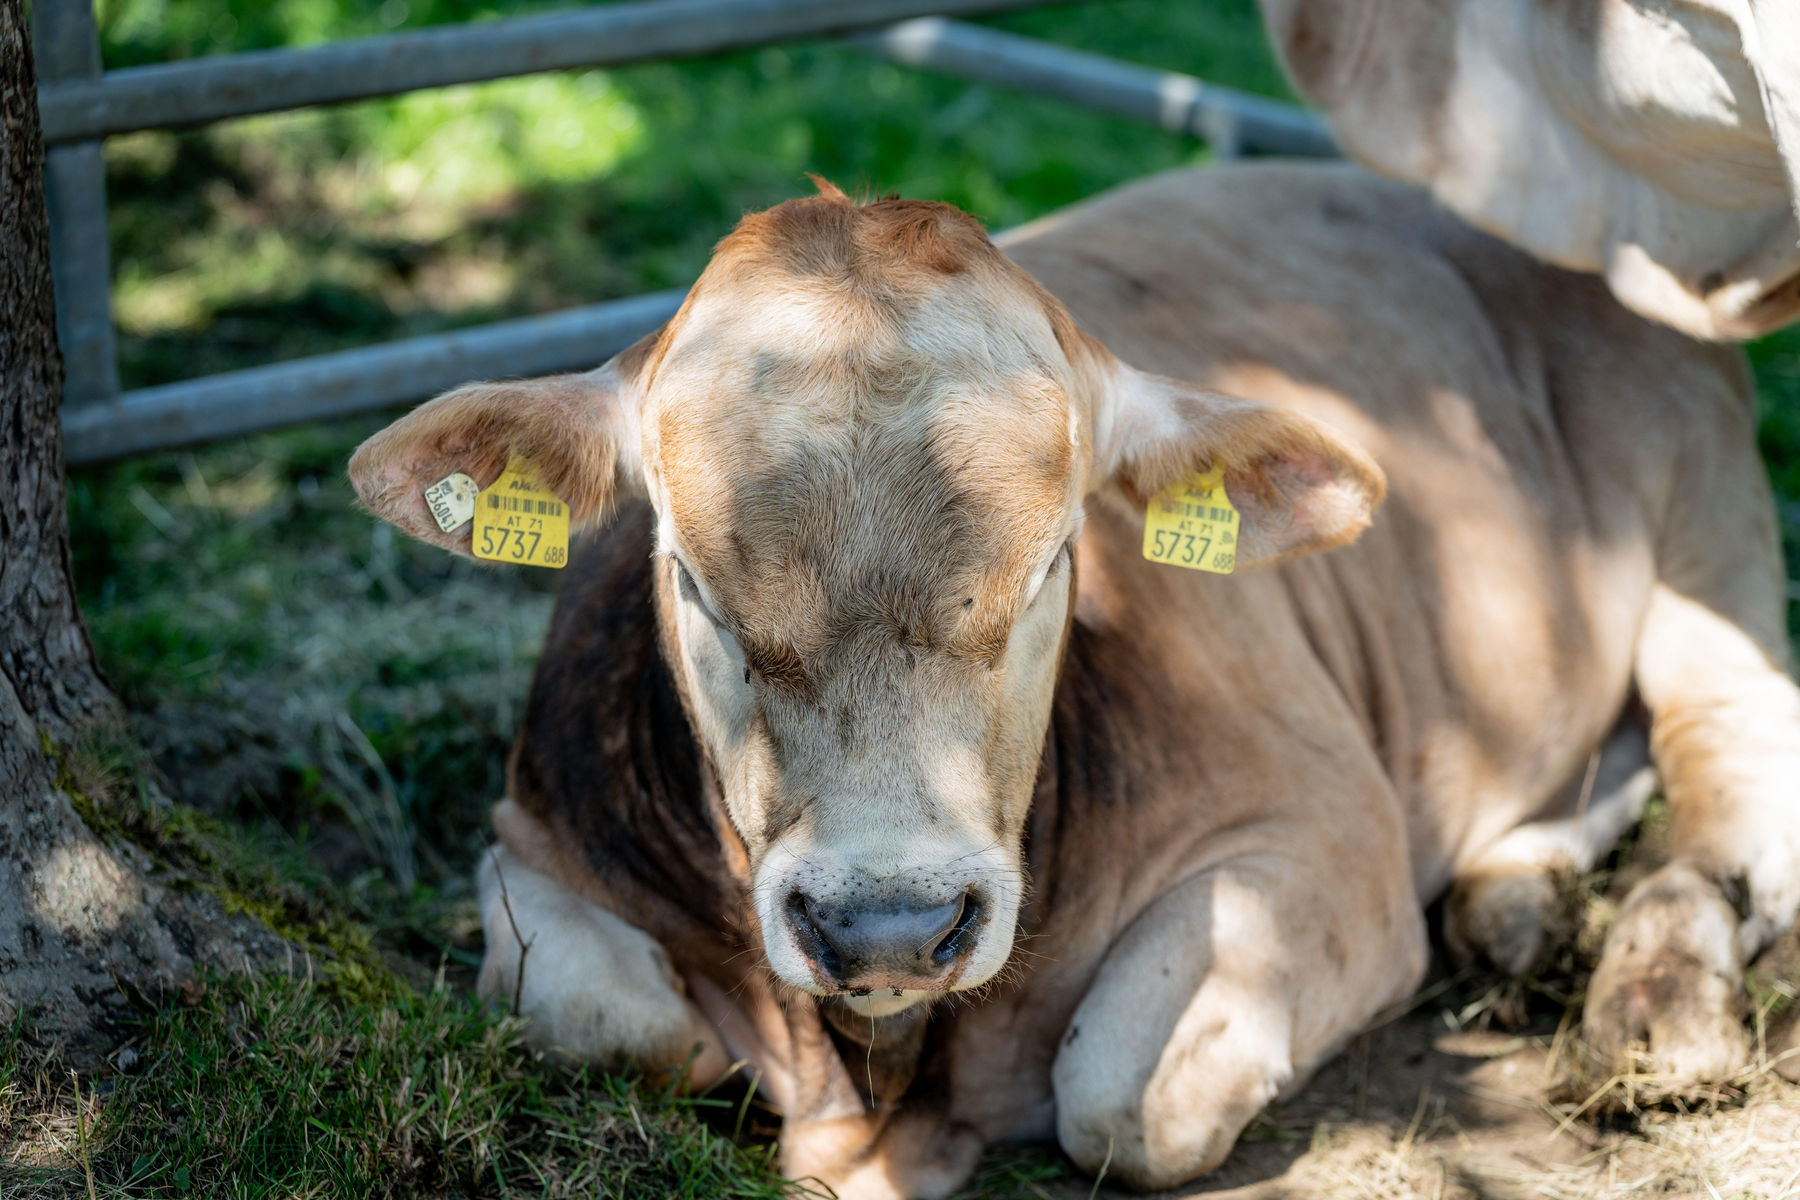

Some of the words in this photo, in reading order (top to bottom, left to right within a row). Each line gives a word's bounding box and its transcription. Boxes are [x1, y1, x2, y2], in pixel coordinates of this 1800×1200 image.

[426, 487, 456, 532] 236041
[507, 516, 521, 527] AT
[529, 518, 543, 530] 71
[1179, 521, 1192, 531] AT
[1200, 523, 1214, 536] 71
[480, 525, 542, 561] 5737
[544, 546, 565, 565] 688
[1152, 529, 1212, 565] 5737
[1212, 552, 1234, 570] 688
